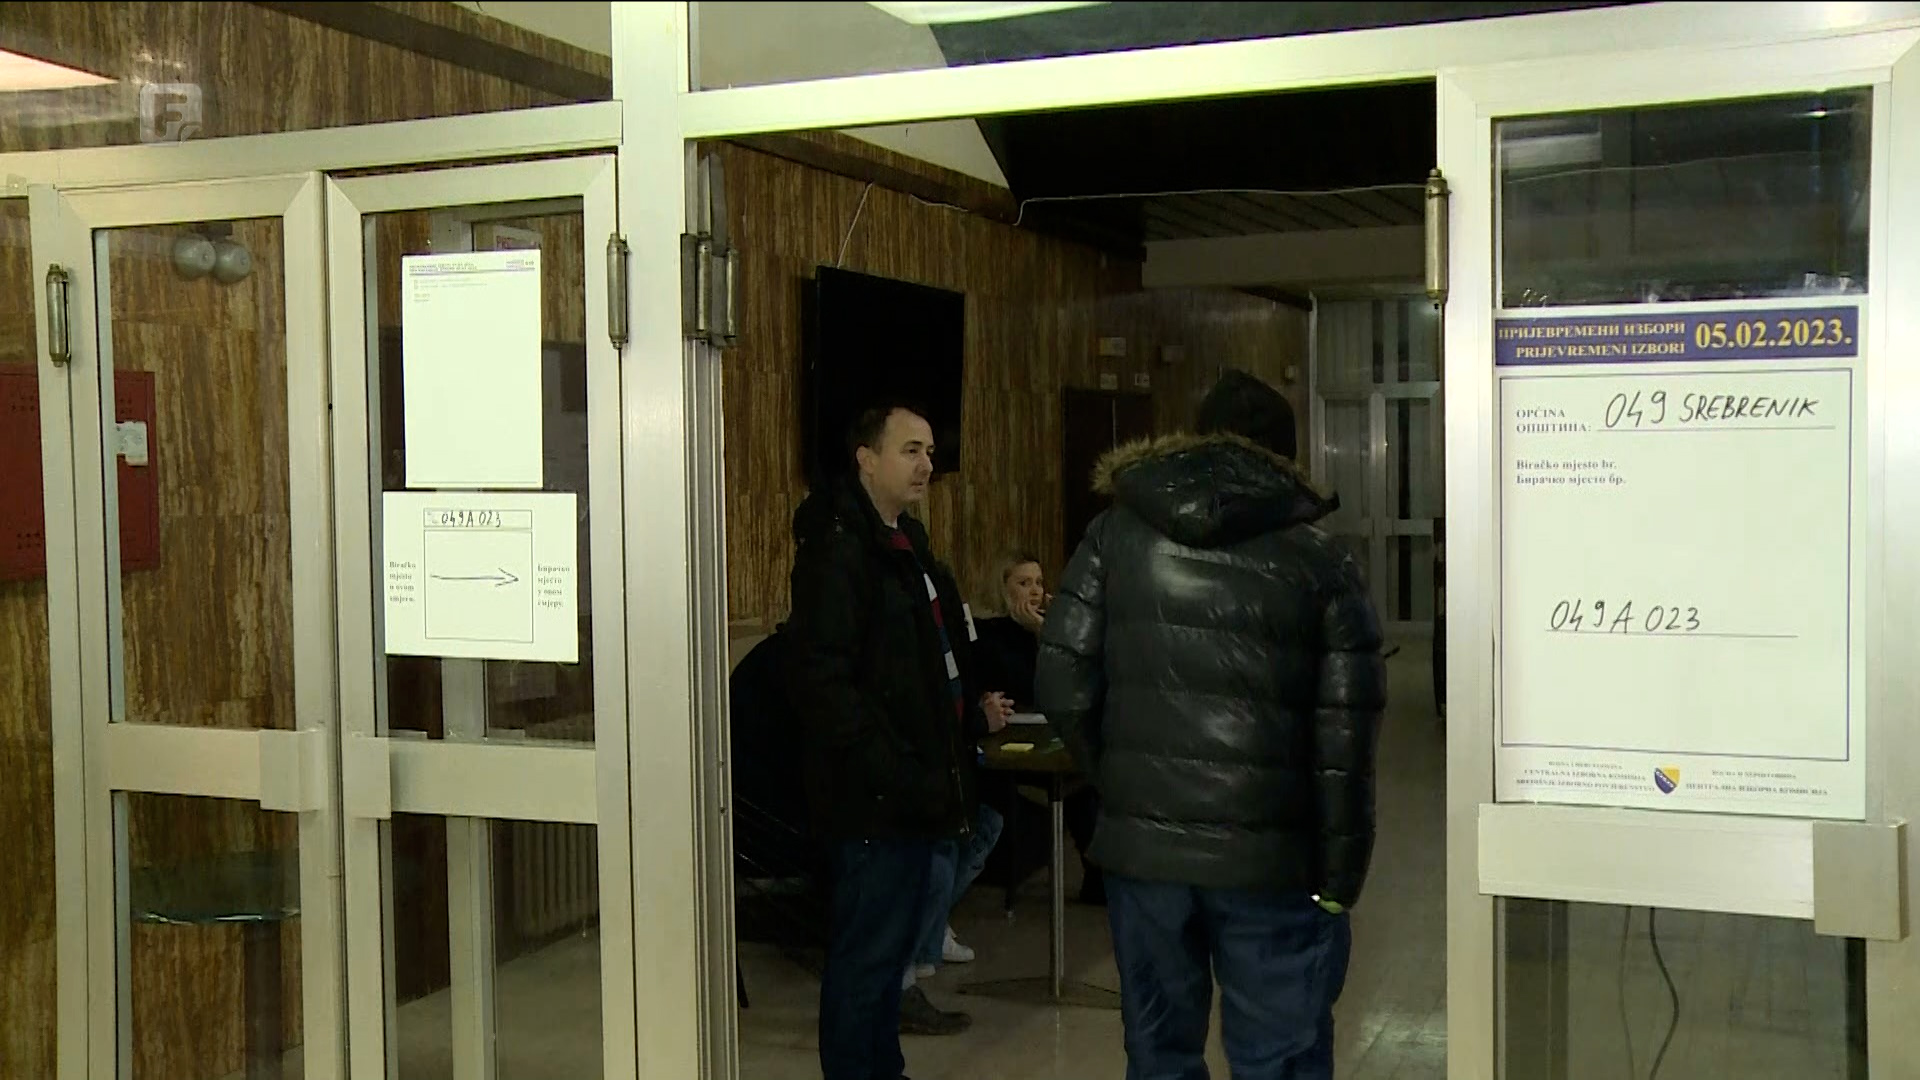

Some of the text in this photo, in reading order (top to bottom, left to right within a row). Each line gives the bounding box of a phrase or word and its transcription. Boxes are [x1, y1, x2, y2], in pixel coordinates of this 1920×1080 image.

[1499, 322, 1686, 340] ПРИЈЕВРЕМЕНИ ИЗБОРИ
[1695, 318, 1853, 349] 05.02.2023.
[1516, 342, 1685, 358] PRIJEVREMENI IZBORI
[1605, 390, 1819, 428] 049 SREBRENIK
[1645, 605, 1700, 632] 023
